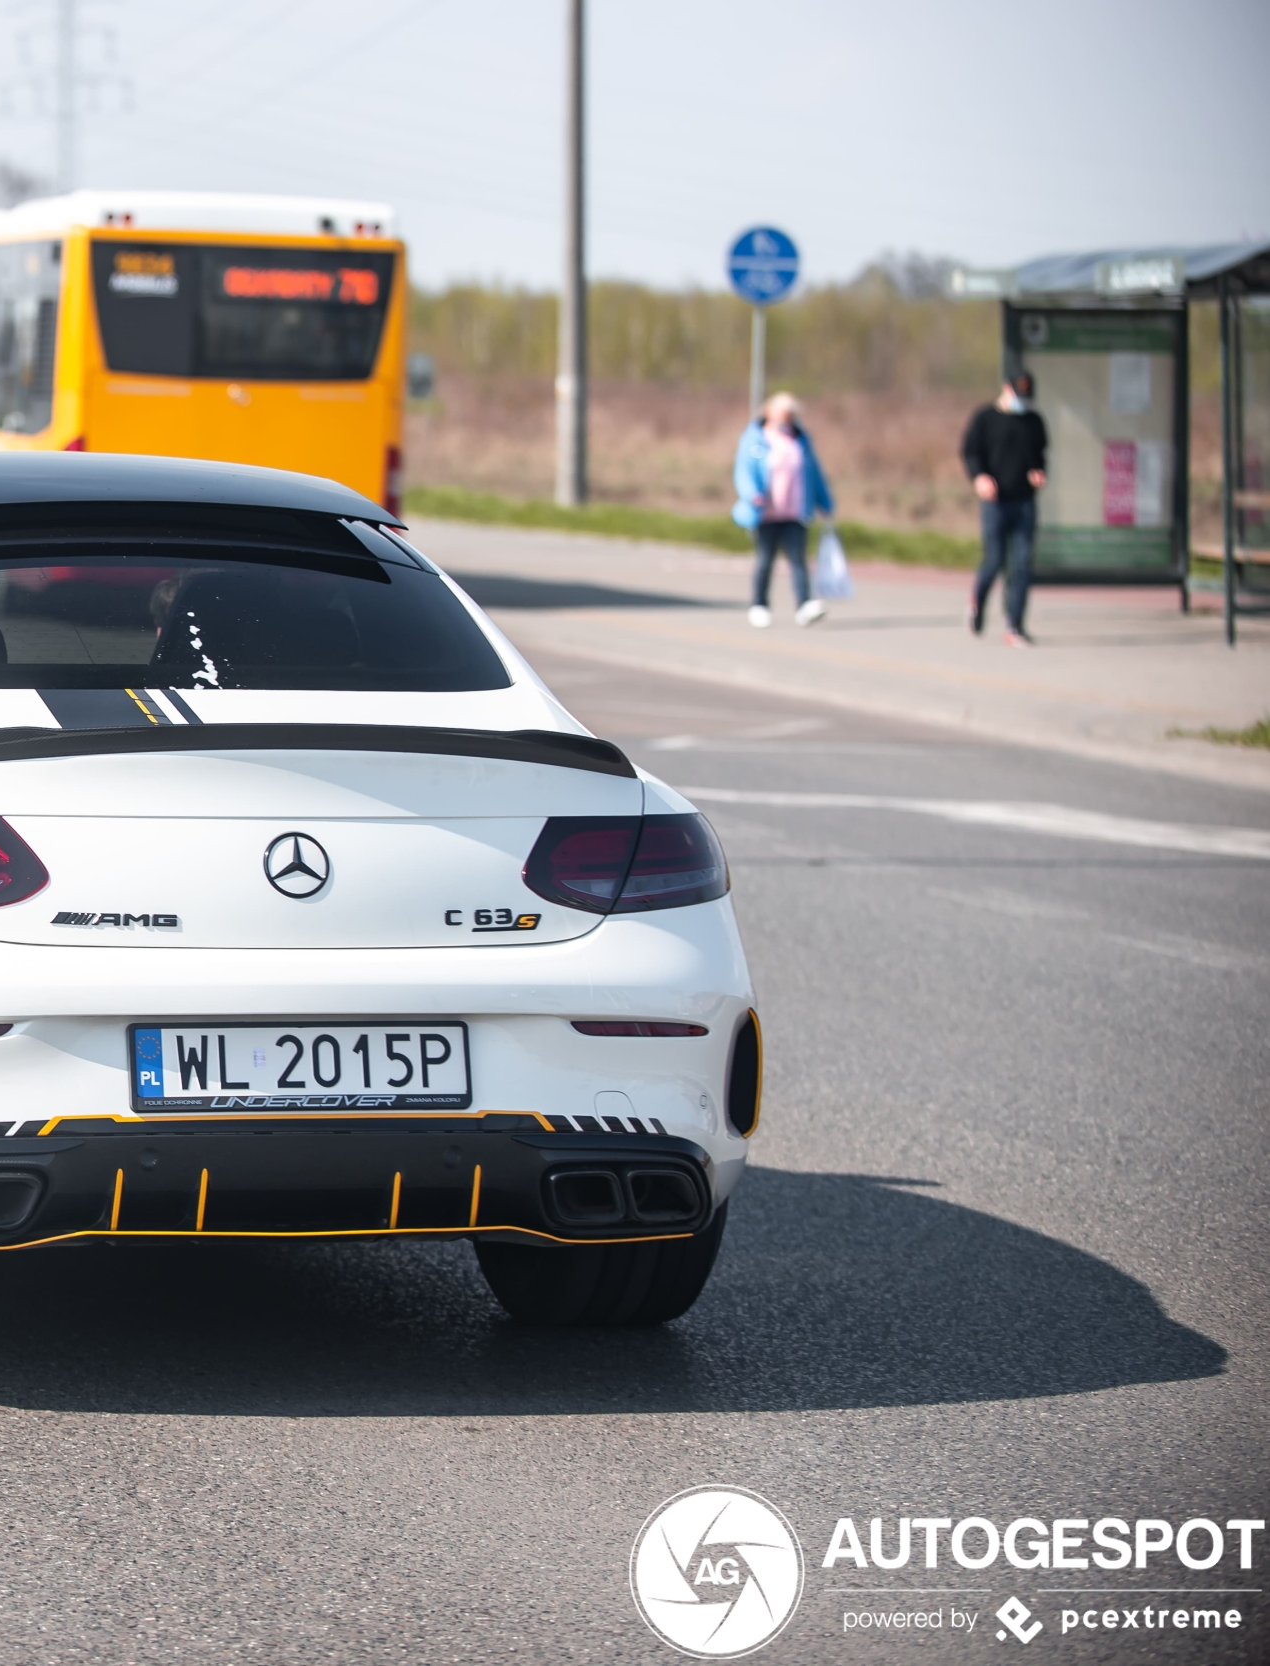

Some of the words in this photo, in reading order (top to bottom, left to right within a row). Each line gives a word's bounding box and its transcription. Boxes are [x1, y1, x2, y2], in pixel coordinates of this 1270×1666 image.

[92, 912, 178, 927] AMG
[444, 909, 463, 926] C
[175, 1034, 250, 1090] WL
[275, 1033, 452, 1089] 2015P
[140, 1071, 161, 1086] PL
[210, 1095, 397, 1108] UNDERCOVER
